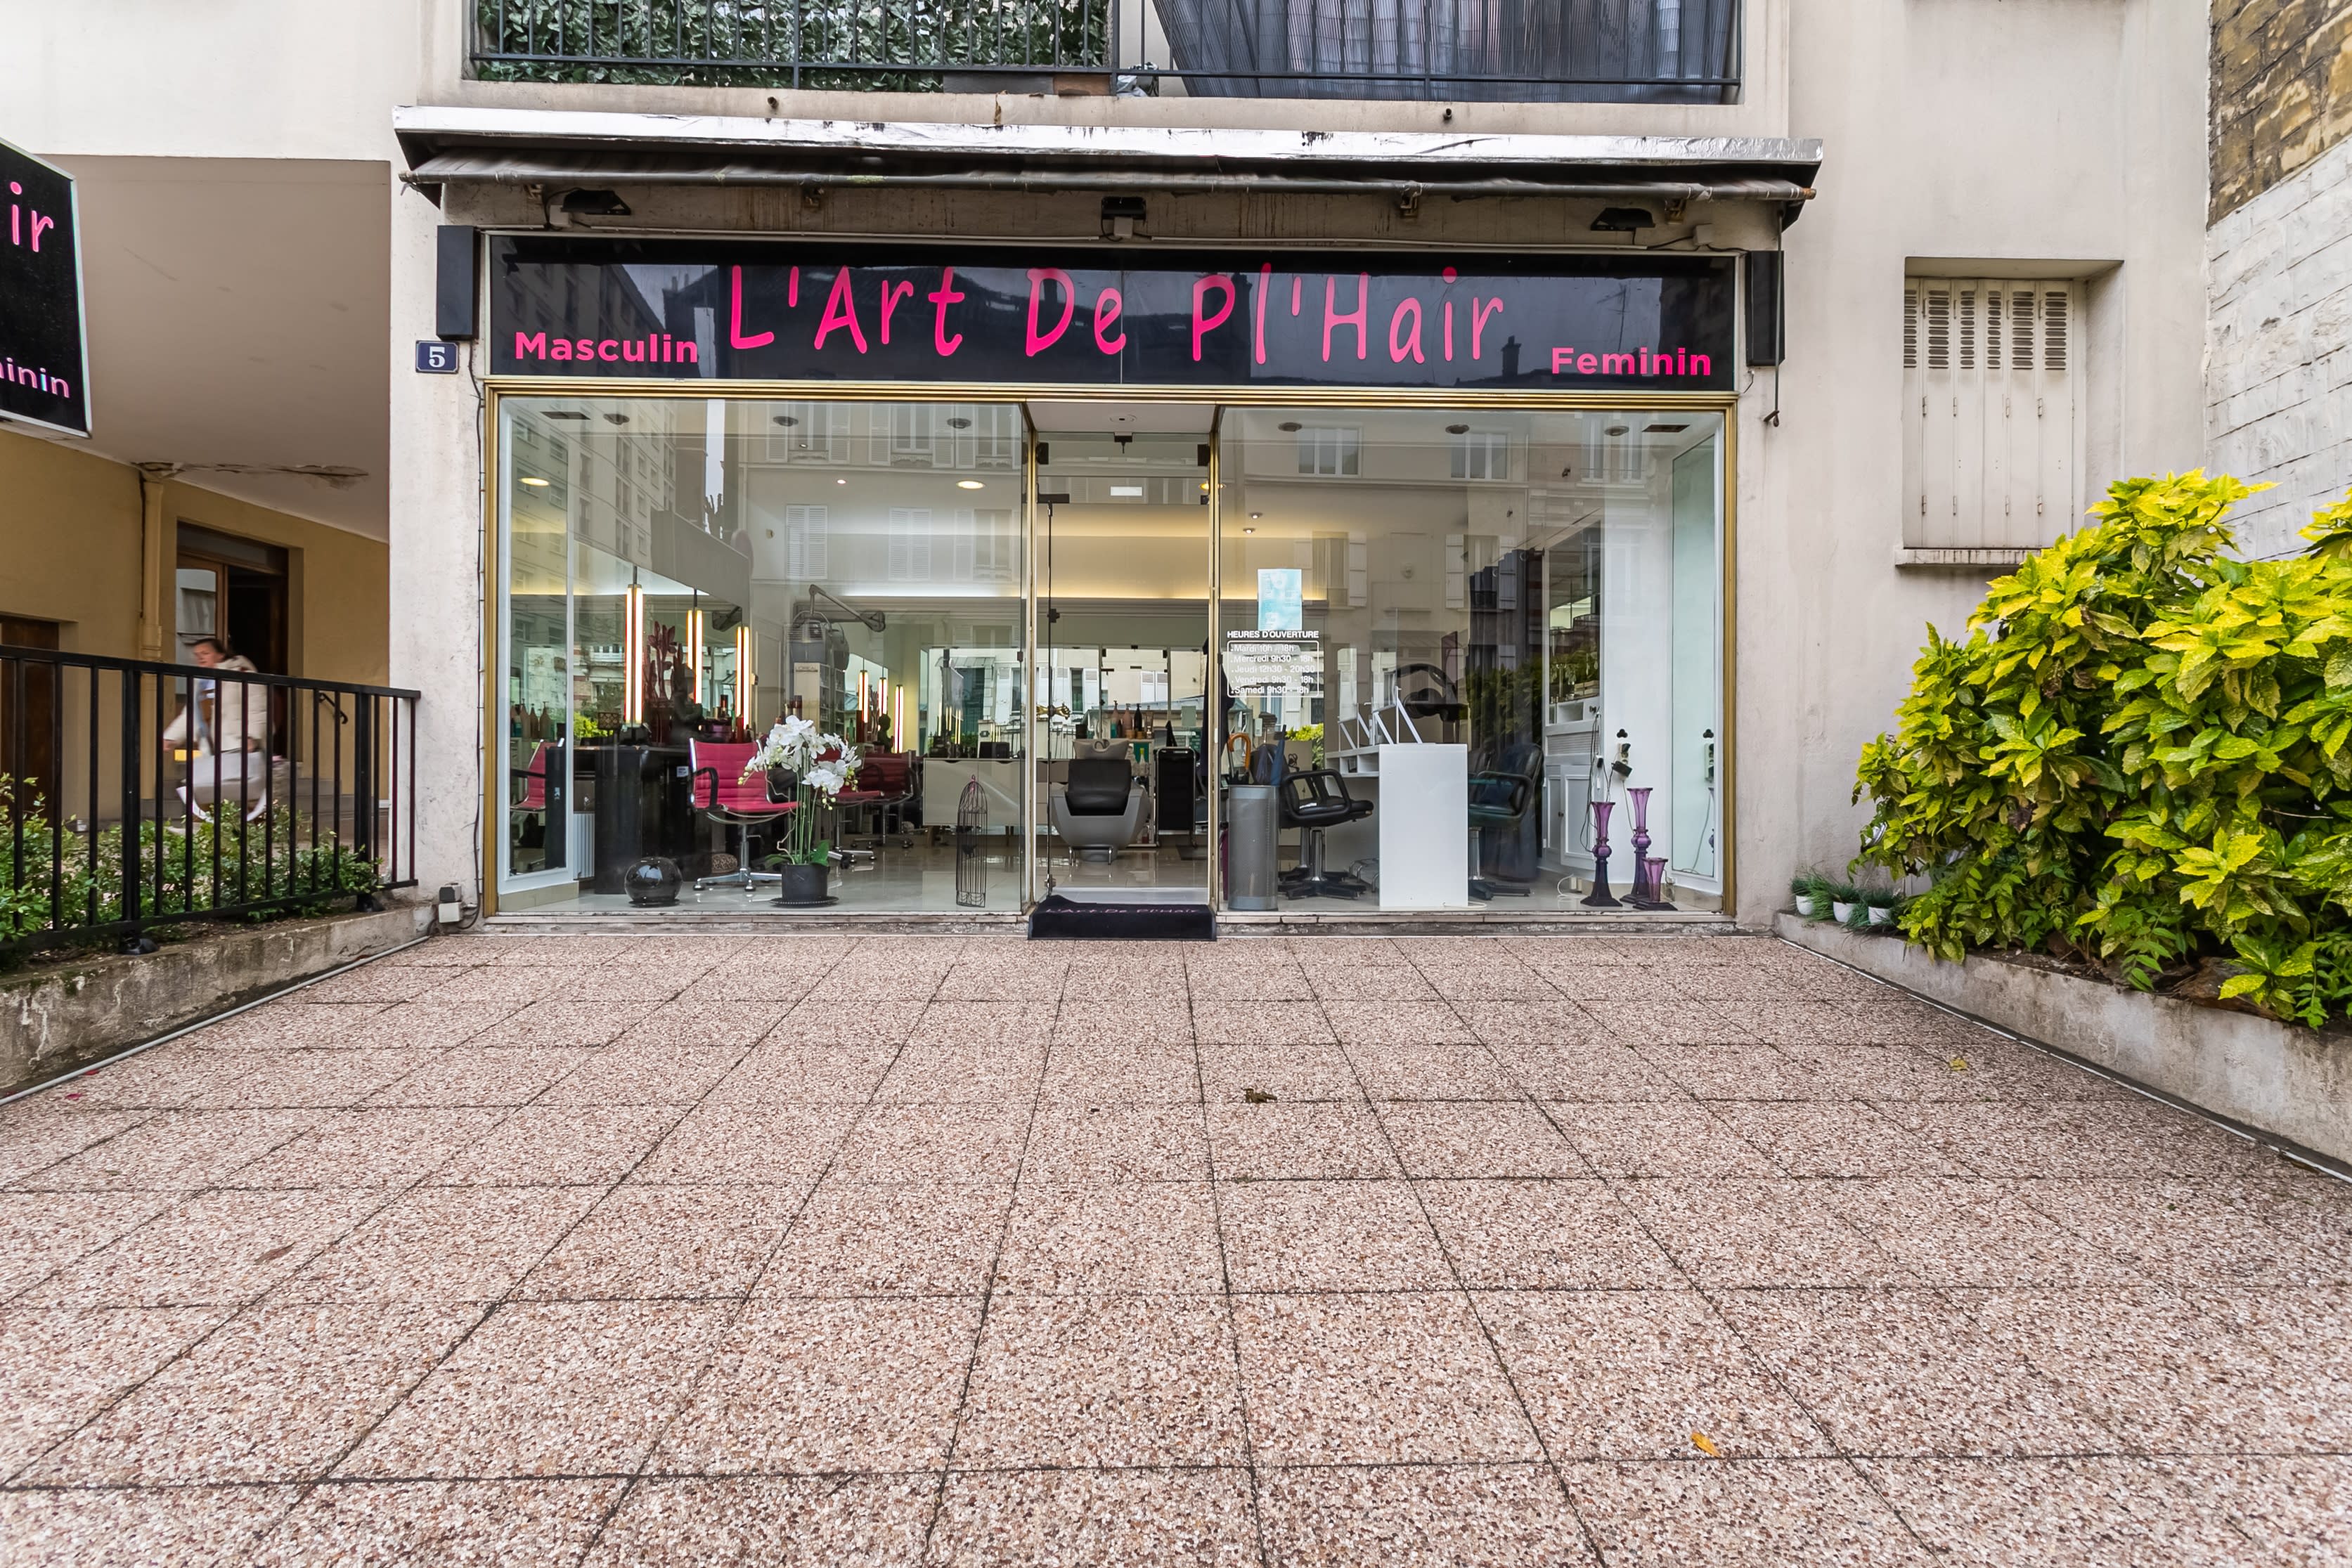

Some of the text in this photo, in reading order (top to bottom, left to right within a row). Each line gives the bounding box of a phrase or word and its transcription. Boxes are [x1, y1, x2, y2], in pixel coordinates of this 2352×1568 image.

[730, 263, 1504, 365] L'Art De Pl'Hair
[429, 345, 446, 368] 5
[515, 331, 699, 364] Masculin
[1551, 346, 1712, 377] Feminin
[0, 356, 70, 399] inin
